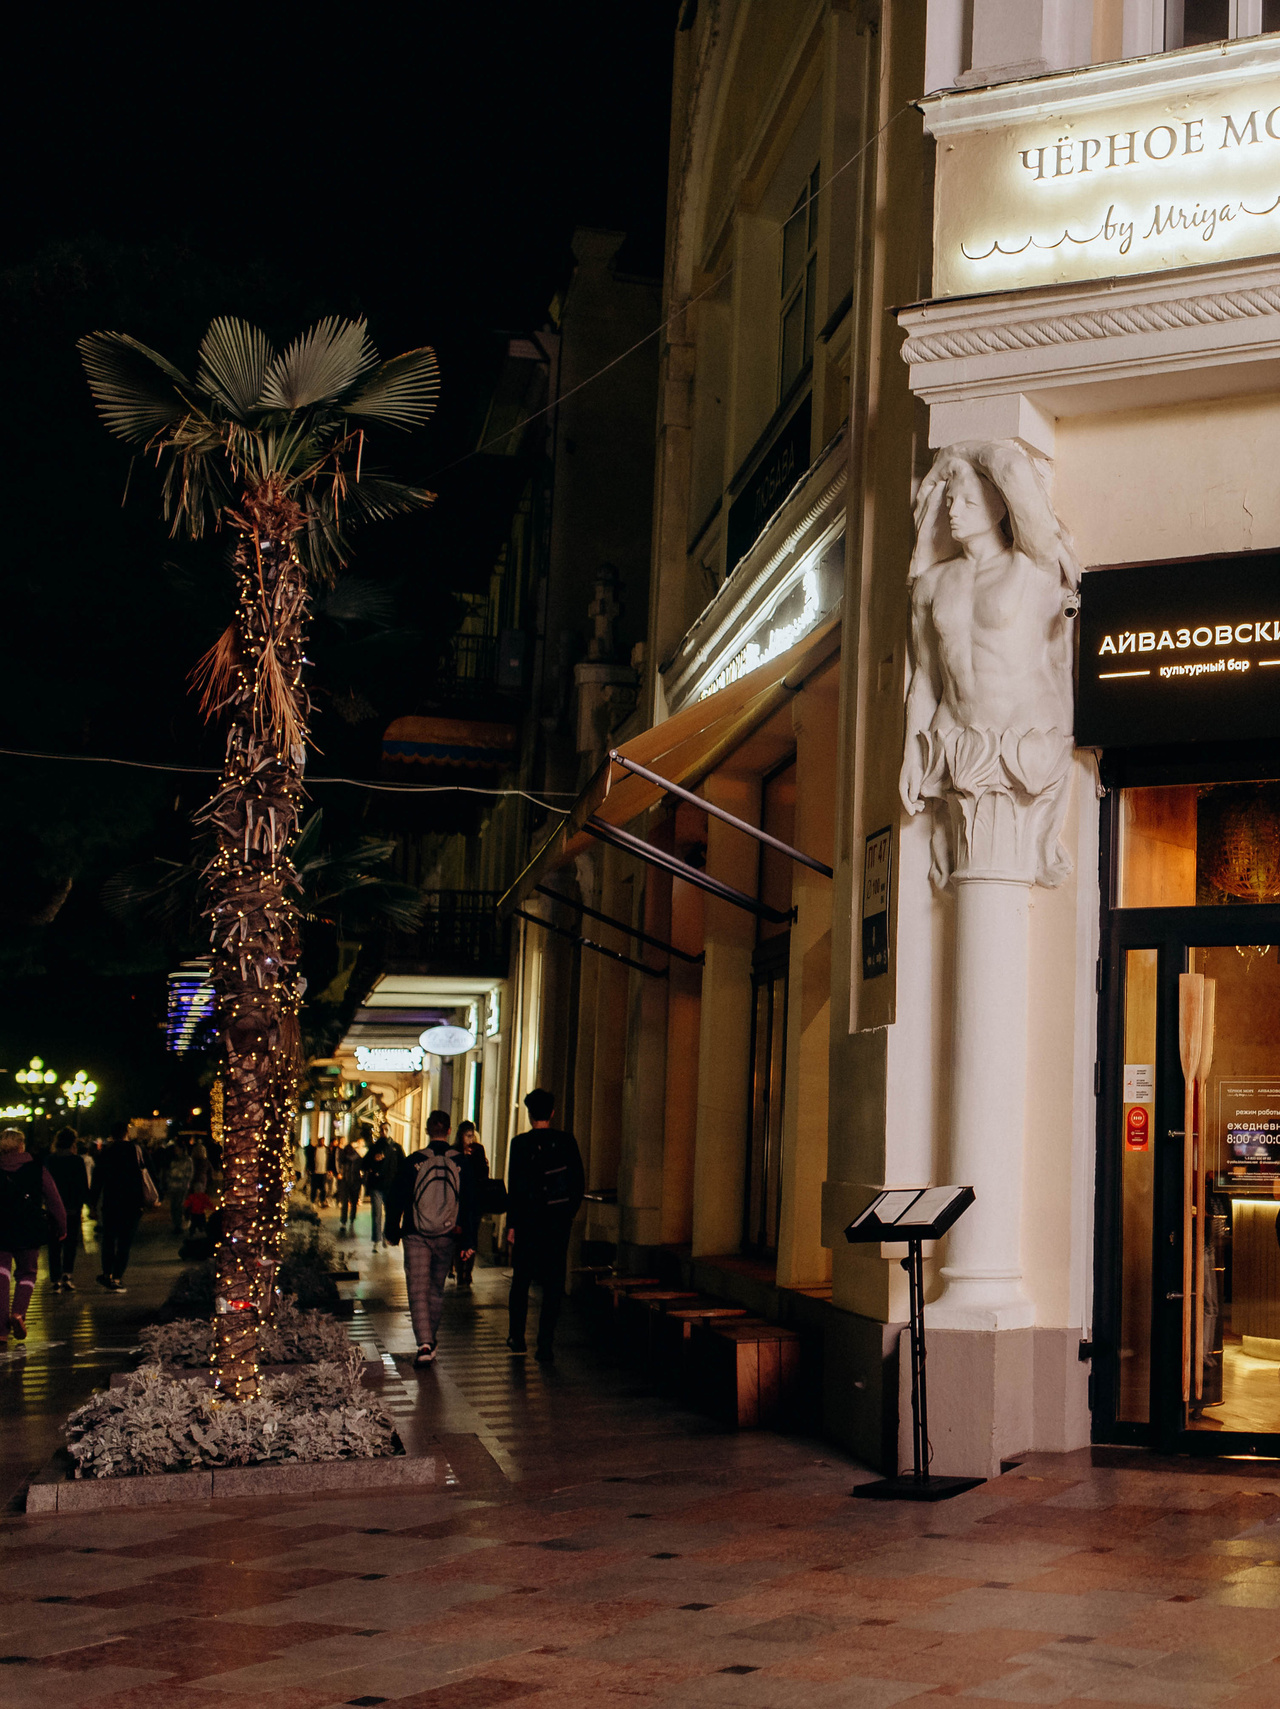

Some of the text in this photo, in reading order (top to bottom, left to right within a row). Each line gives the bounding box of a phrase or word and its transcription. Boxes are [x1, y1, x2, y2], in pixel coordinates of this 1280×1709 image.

[1018, 118, 1205, 181] ЧЁРНОЕ
[1102, 201, 1236, 254] by Mriya
[1159, 658, 1250, 679] культурный бар
[867, 843, 878, 869] ПГ
[1257, 1108, 1280, 1116] работы
[1226, 1134, 1250, 1145] 8:00
